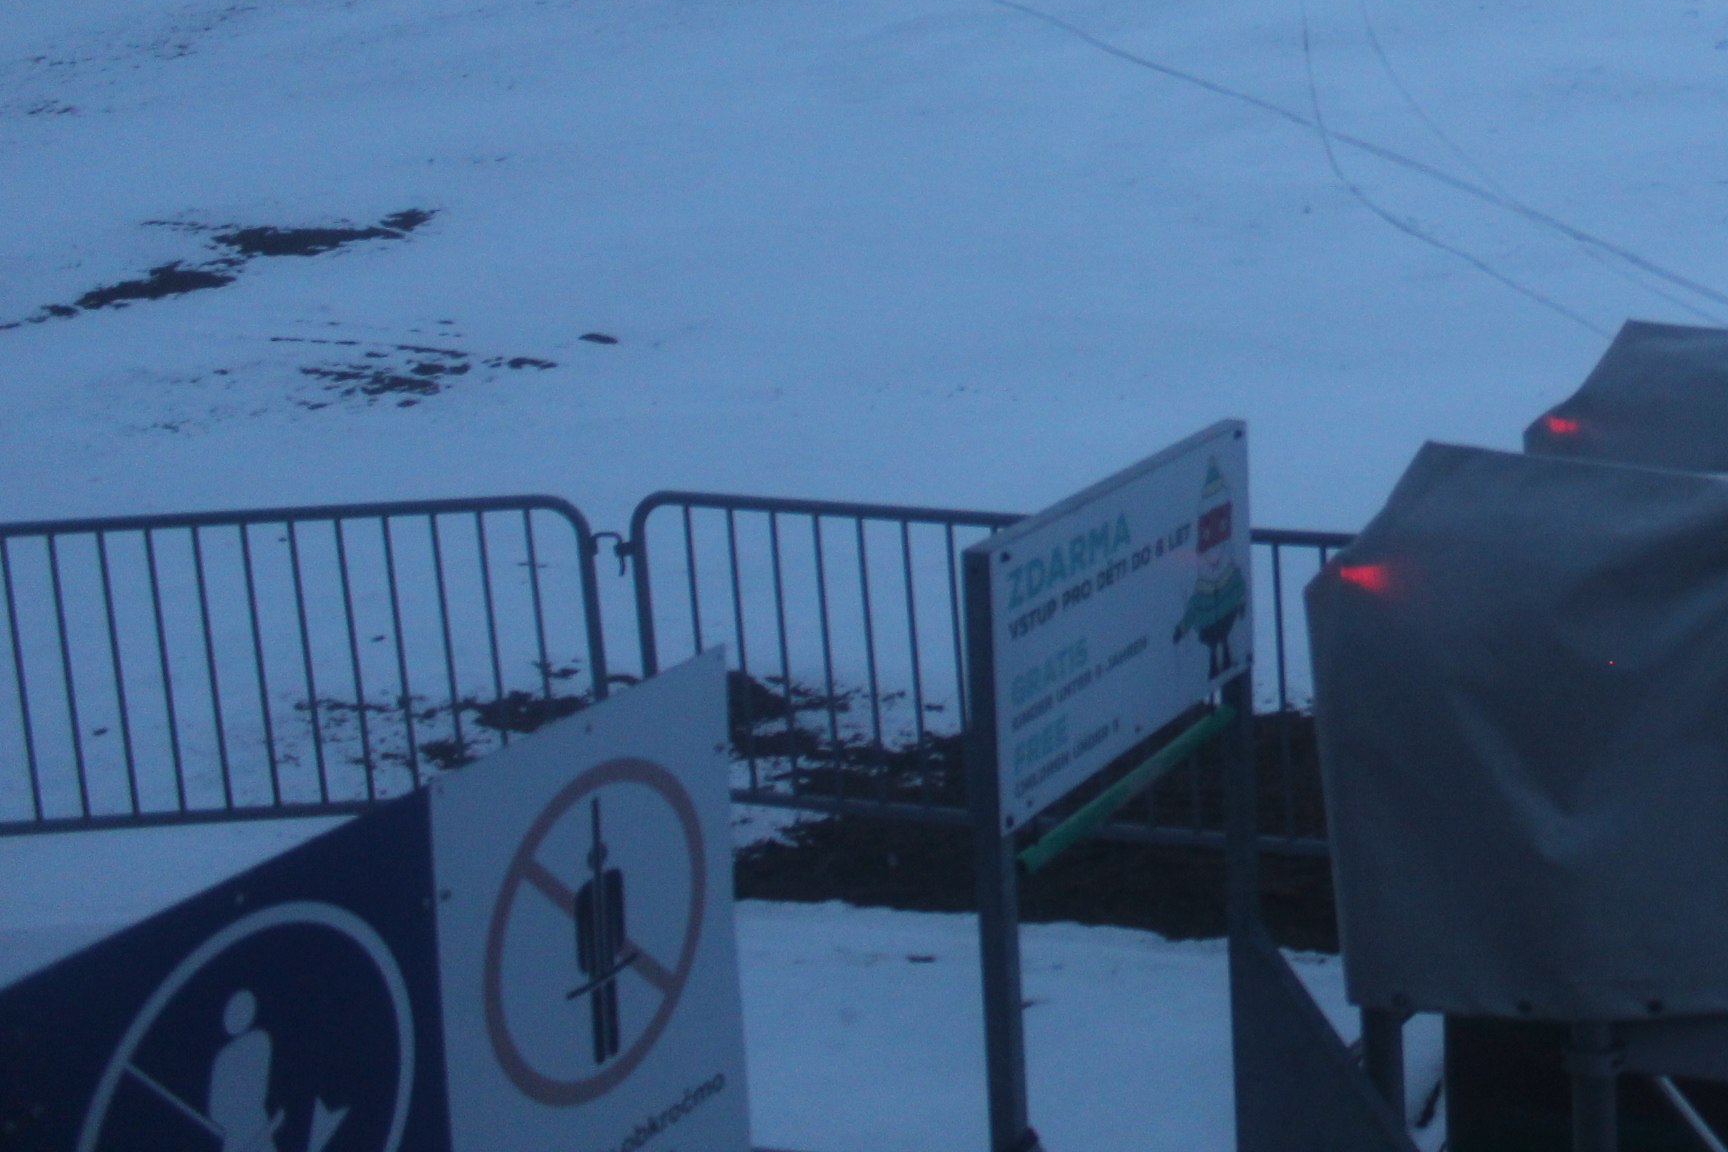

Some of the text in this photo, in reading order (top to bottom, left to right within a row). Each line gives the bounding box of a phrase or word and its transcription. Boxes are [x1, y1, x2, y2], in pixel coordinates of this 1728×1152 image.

[1007, 512, 1131, 610] ZDARMA
[1008, 599, 1058, 640] VSTUP
[1062, 579, 1092, 611] PRO
[1097, 556, 1127, 593] DĚTI
[1131, 545, 1151, 573] DO
[1168, 522, 1191, 551] LET
[1011, 636, 1088, 705] GRATIS
